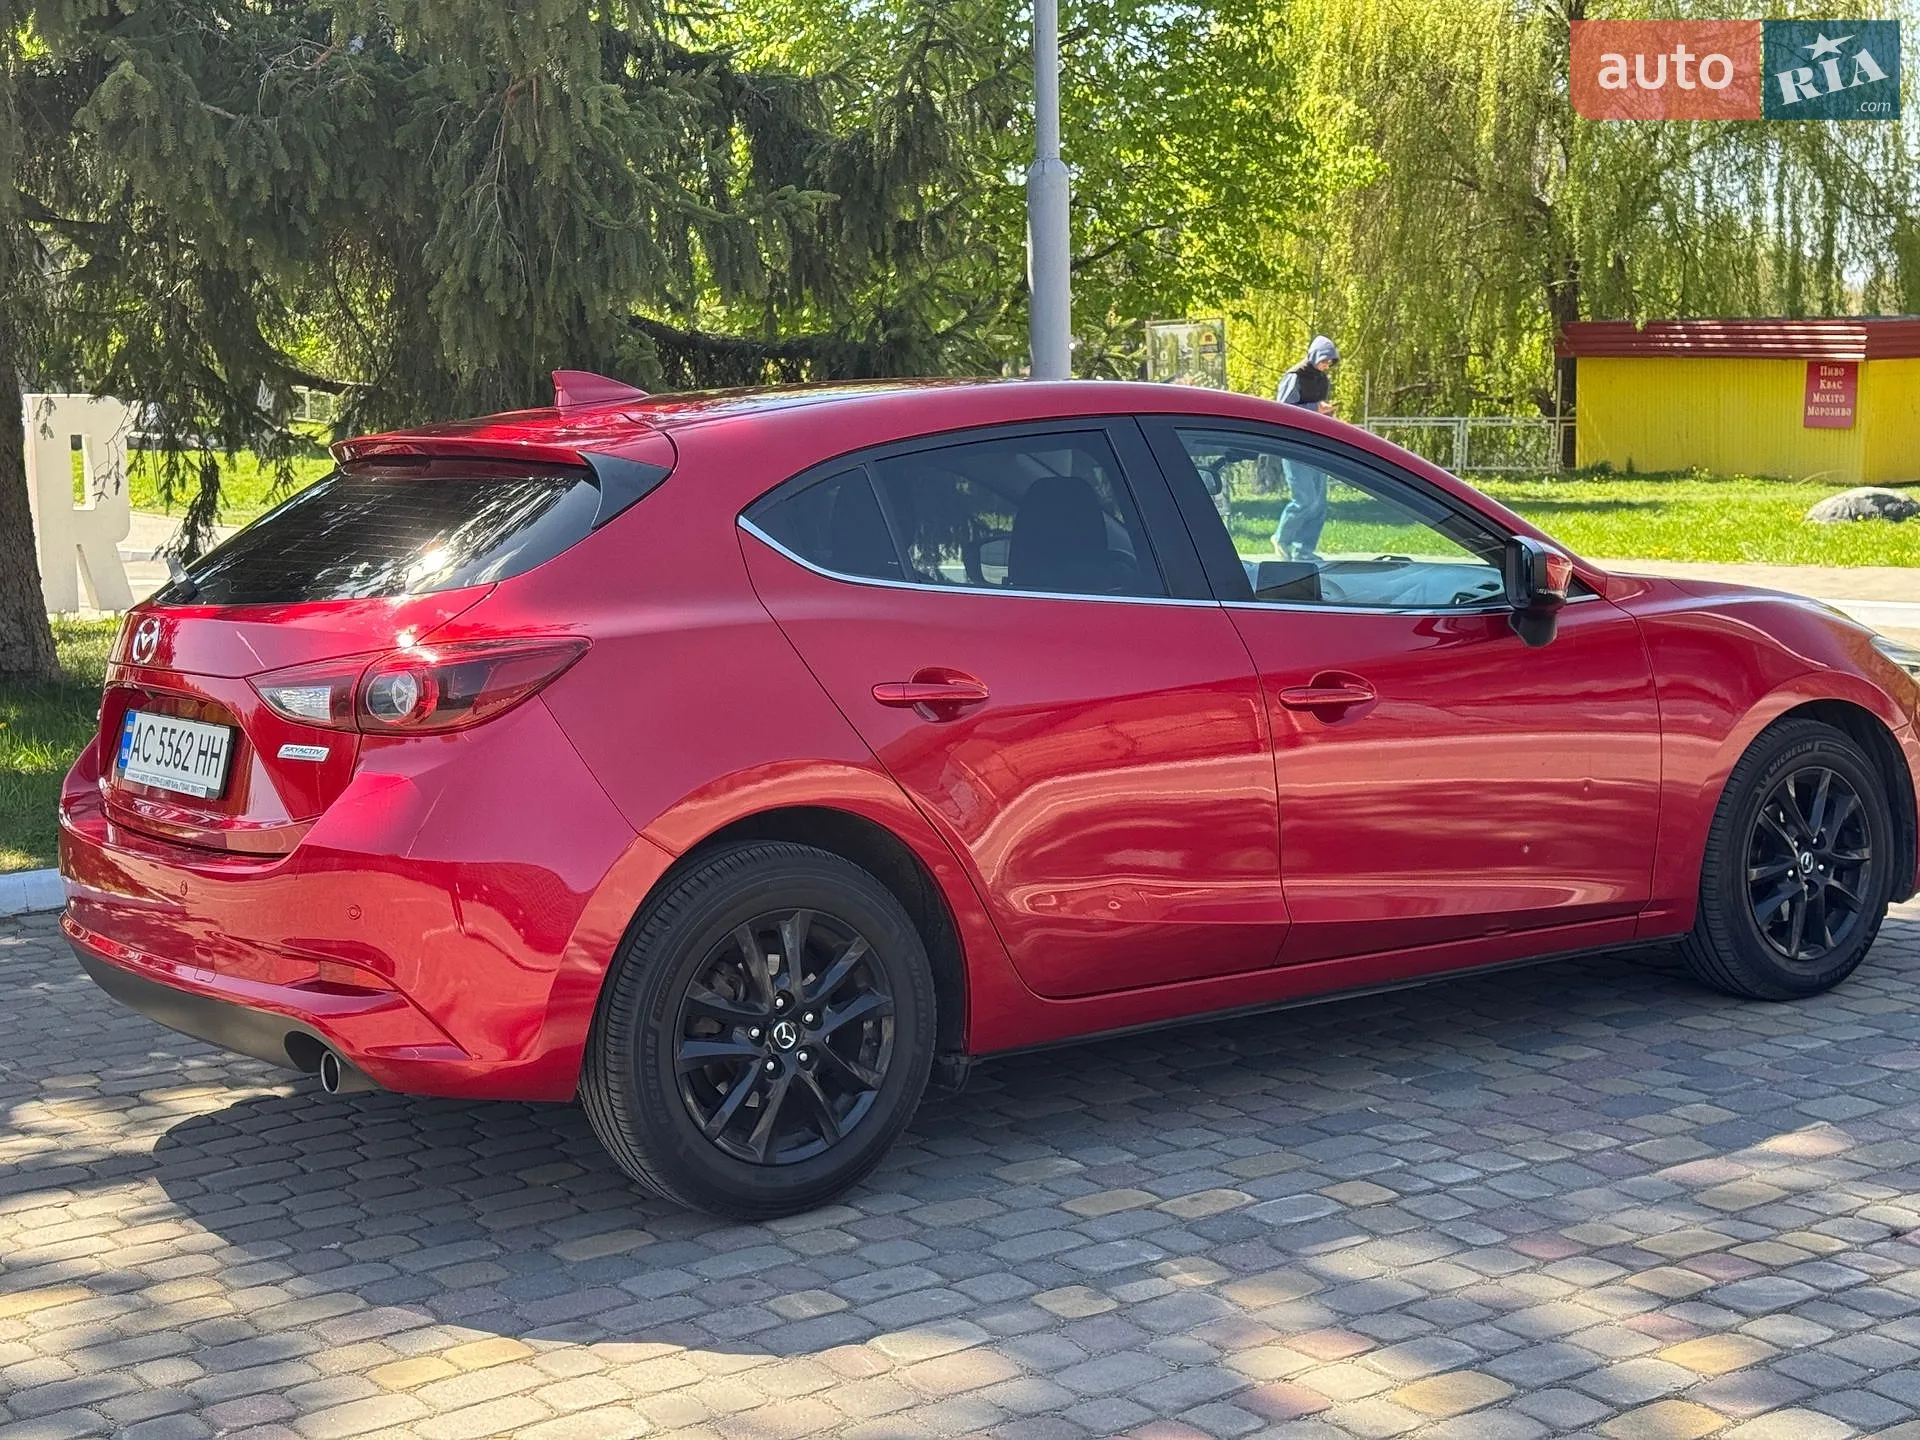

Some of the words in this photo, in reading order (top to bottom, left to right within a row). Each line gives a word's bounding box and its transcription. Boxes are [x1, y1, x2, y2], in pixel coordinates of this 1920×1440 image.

[130, 722, 156, 763] AC
[156, 726, 194, 771] 5562
[194, 734, 224, 778] HH
[1769, 741, 1813, 774] MICHELIN
